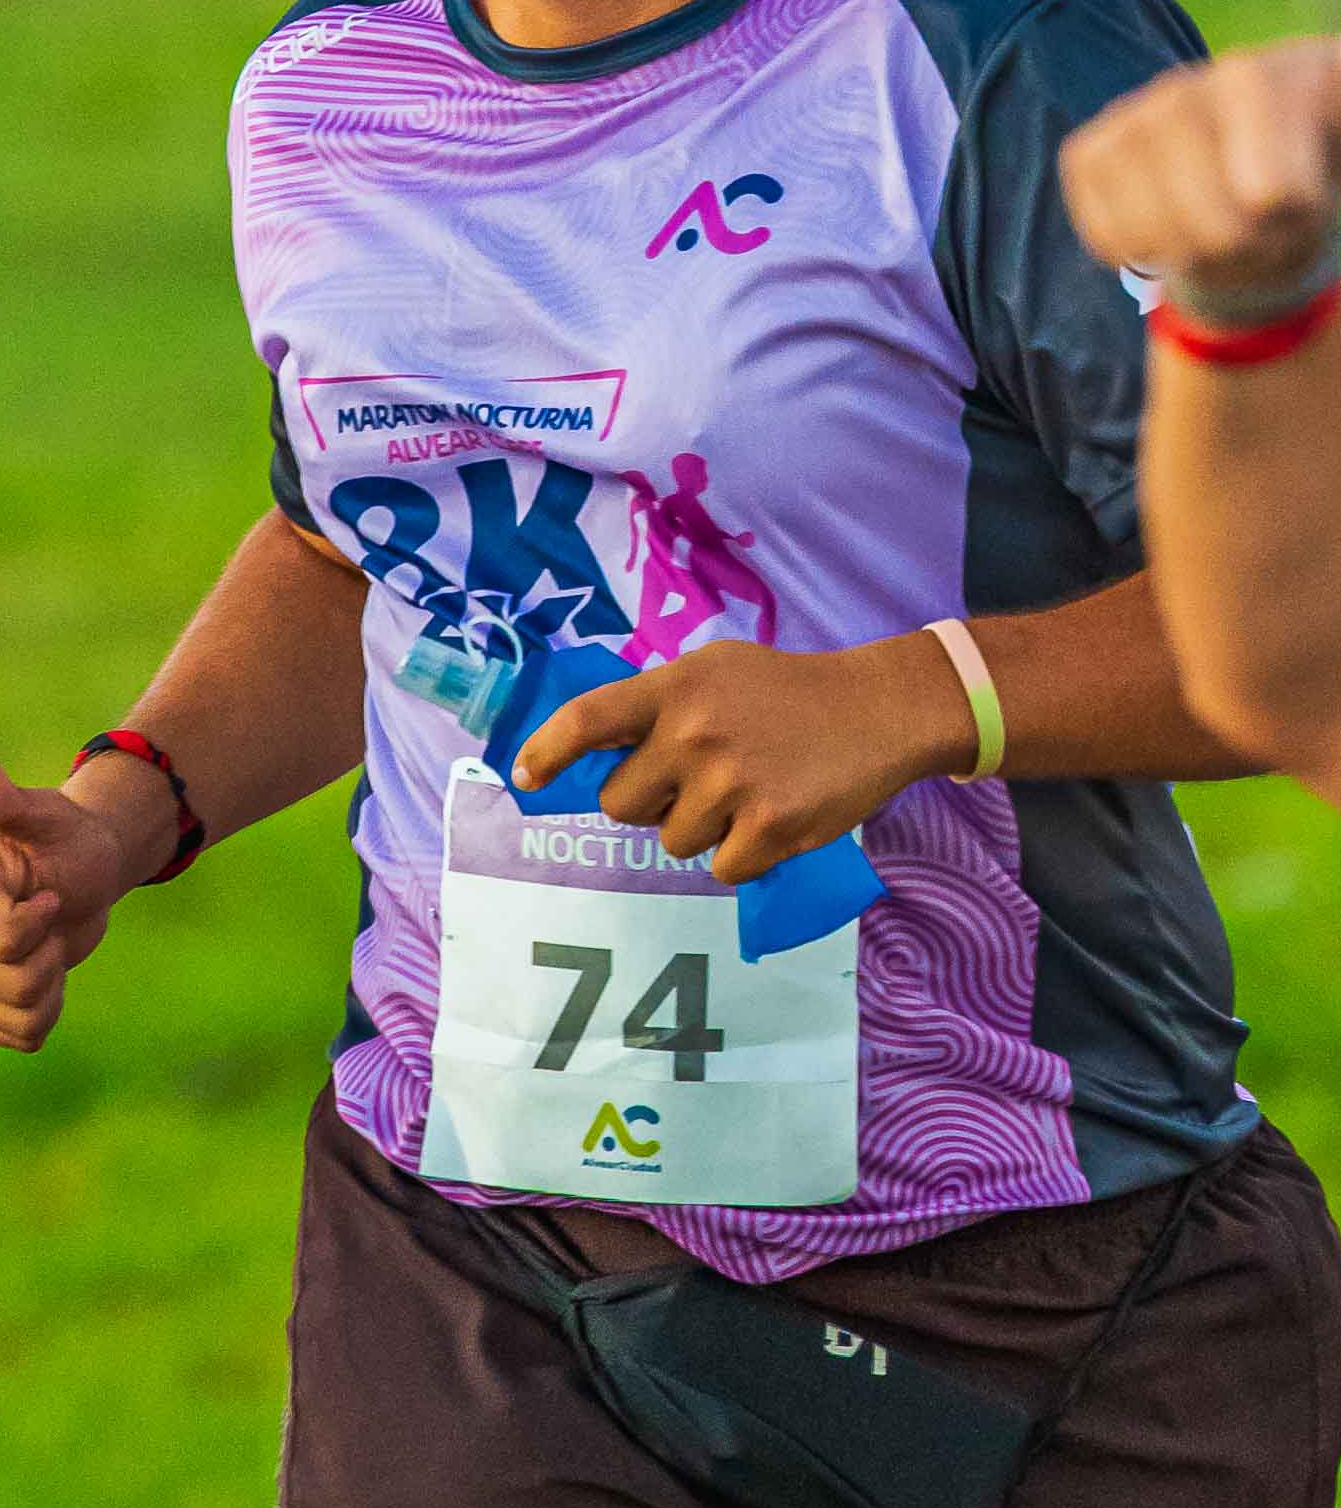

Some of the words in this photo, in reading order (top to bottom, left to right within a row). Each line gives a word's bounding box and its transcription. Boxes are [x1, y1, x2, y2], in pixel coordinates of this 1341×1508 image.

[456, 403, 593, 430] NOCTURNA
[387, 429, 486, 465] ALVEAR
[532, 941, 724, 1082] 74
